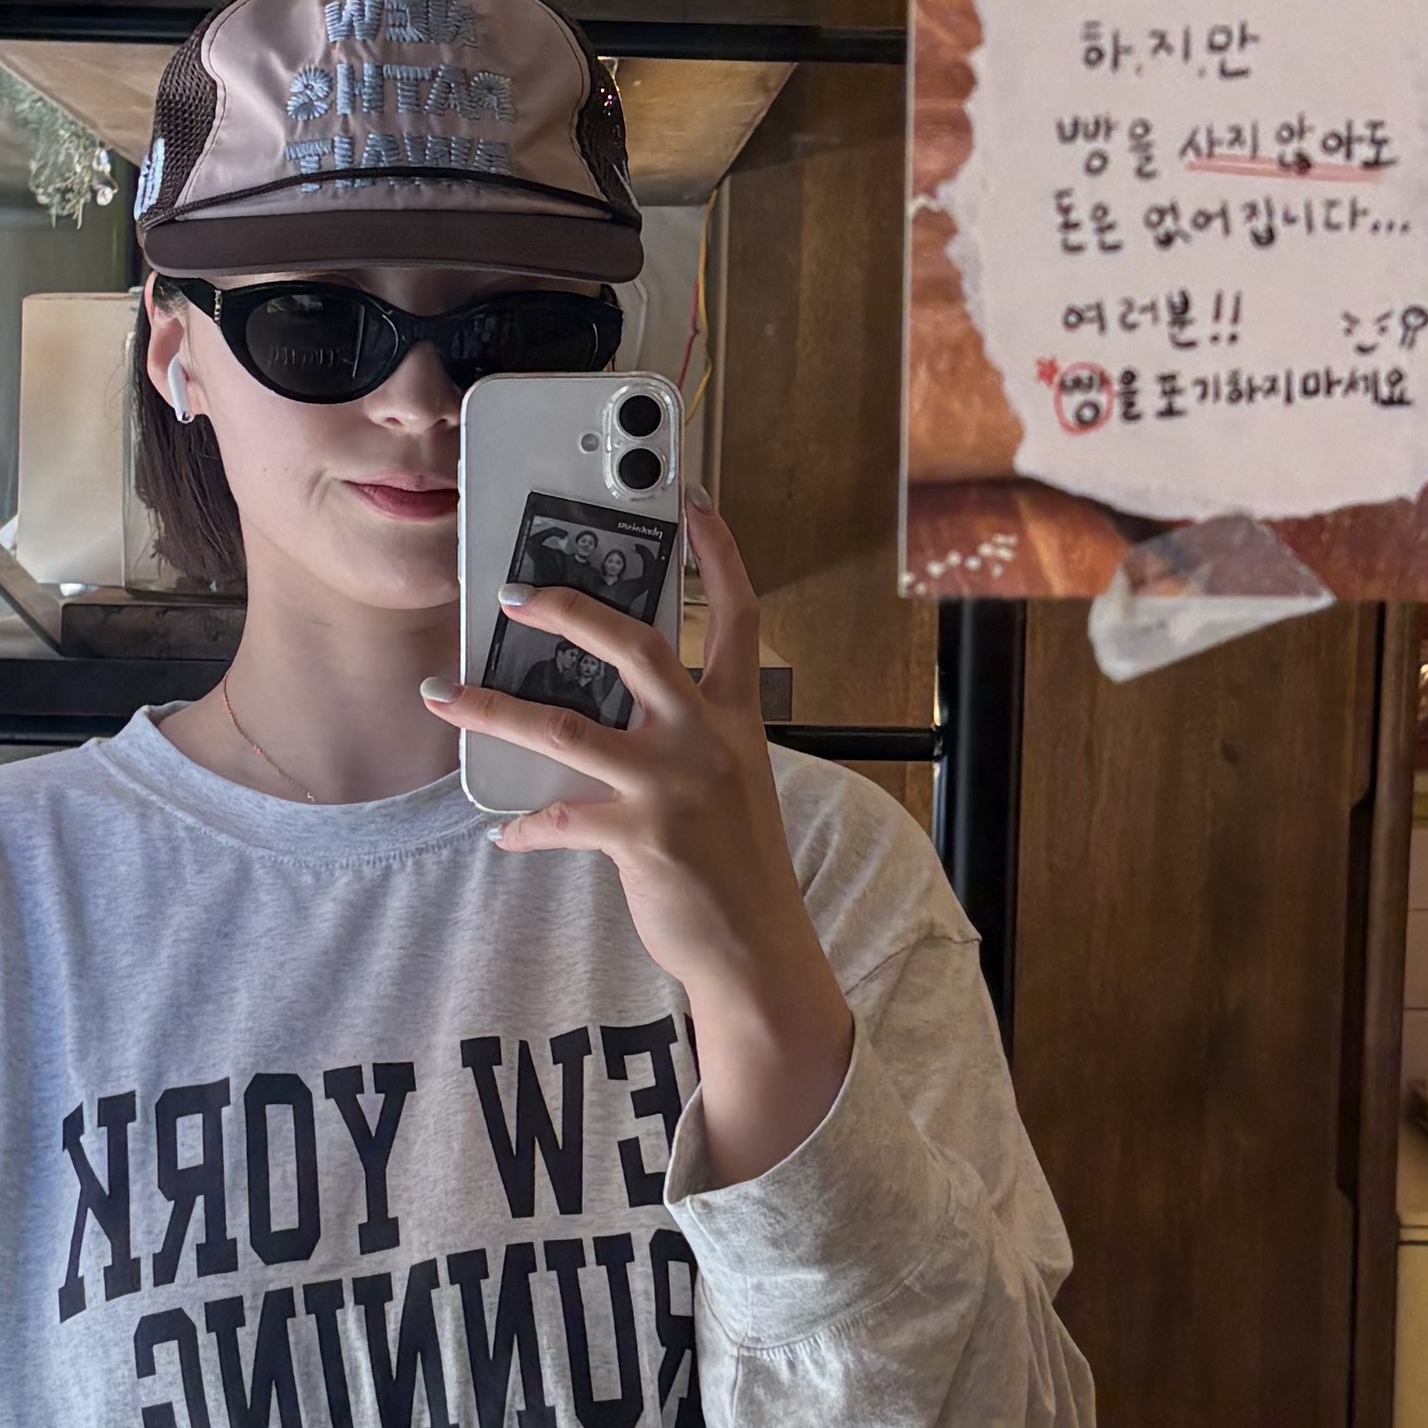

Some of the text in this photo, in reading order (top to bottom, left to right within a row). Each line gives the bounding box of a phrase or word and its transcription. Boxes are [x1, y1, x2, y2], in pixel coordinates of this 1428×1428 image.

[1056, 117, 1160, 180] 빵을
[1053, 189, 1123, 254] 돈은
[1062, 288, 1245, 349] 여러분!!
[1059, 369, 1138, 429] 빵을
